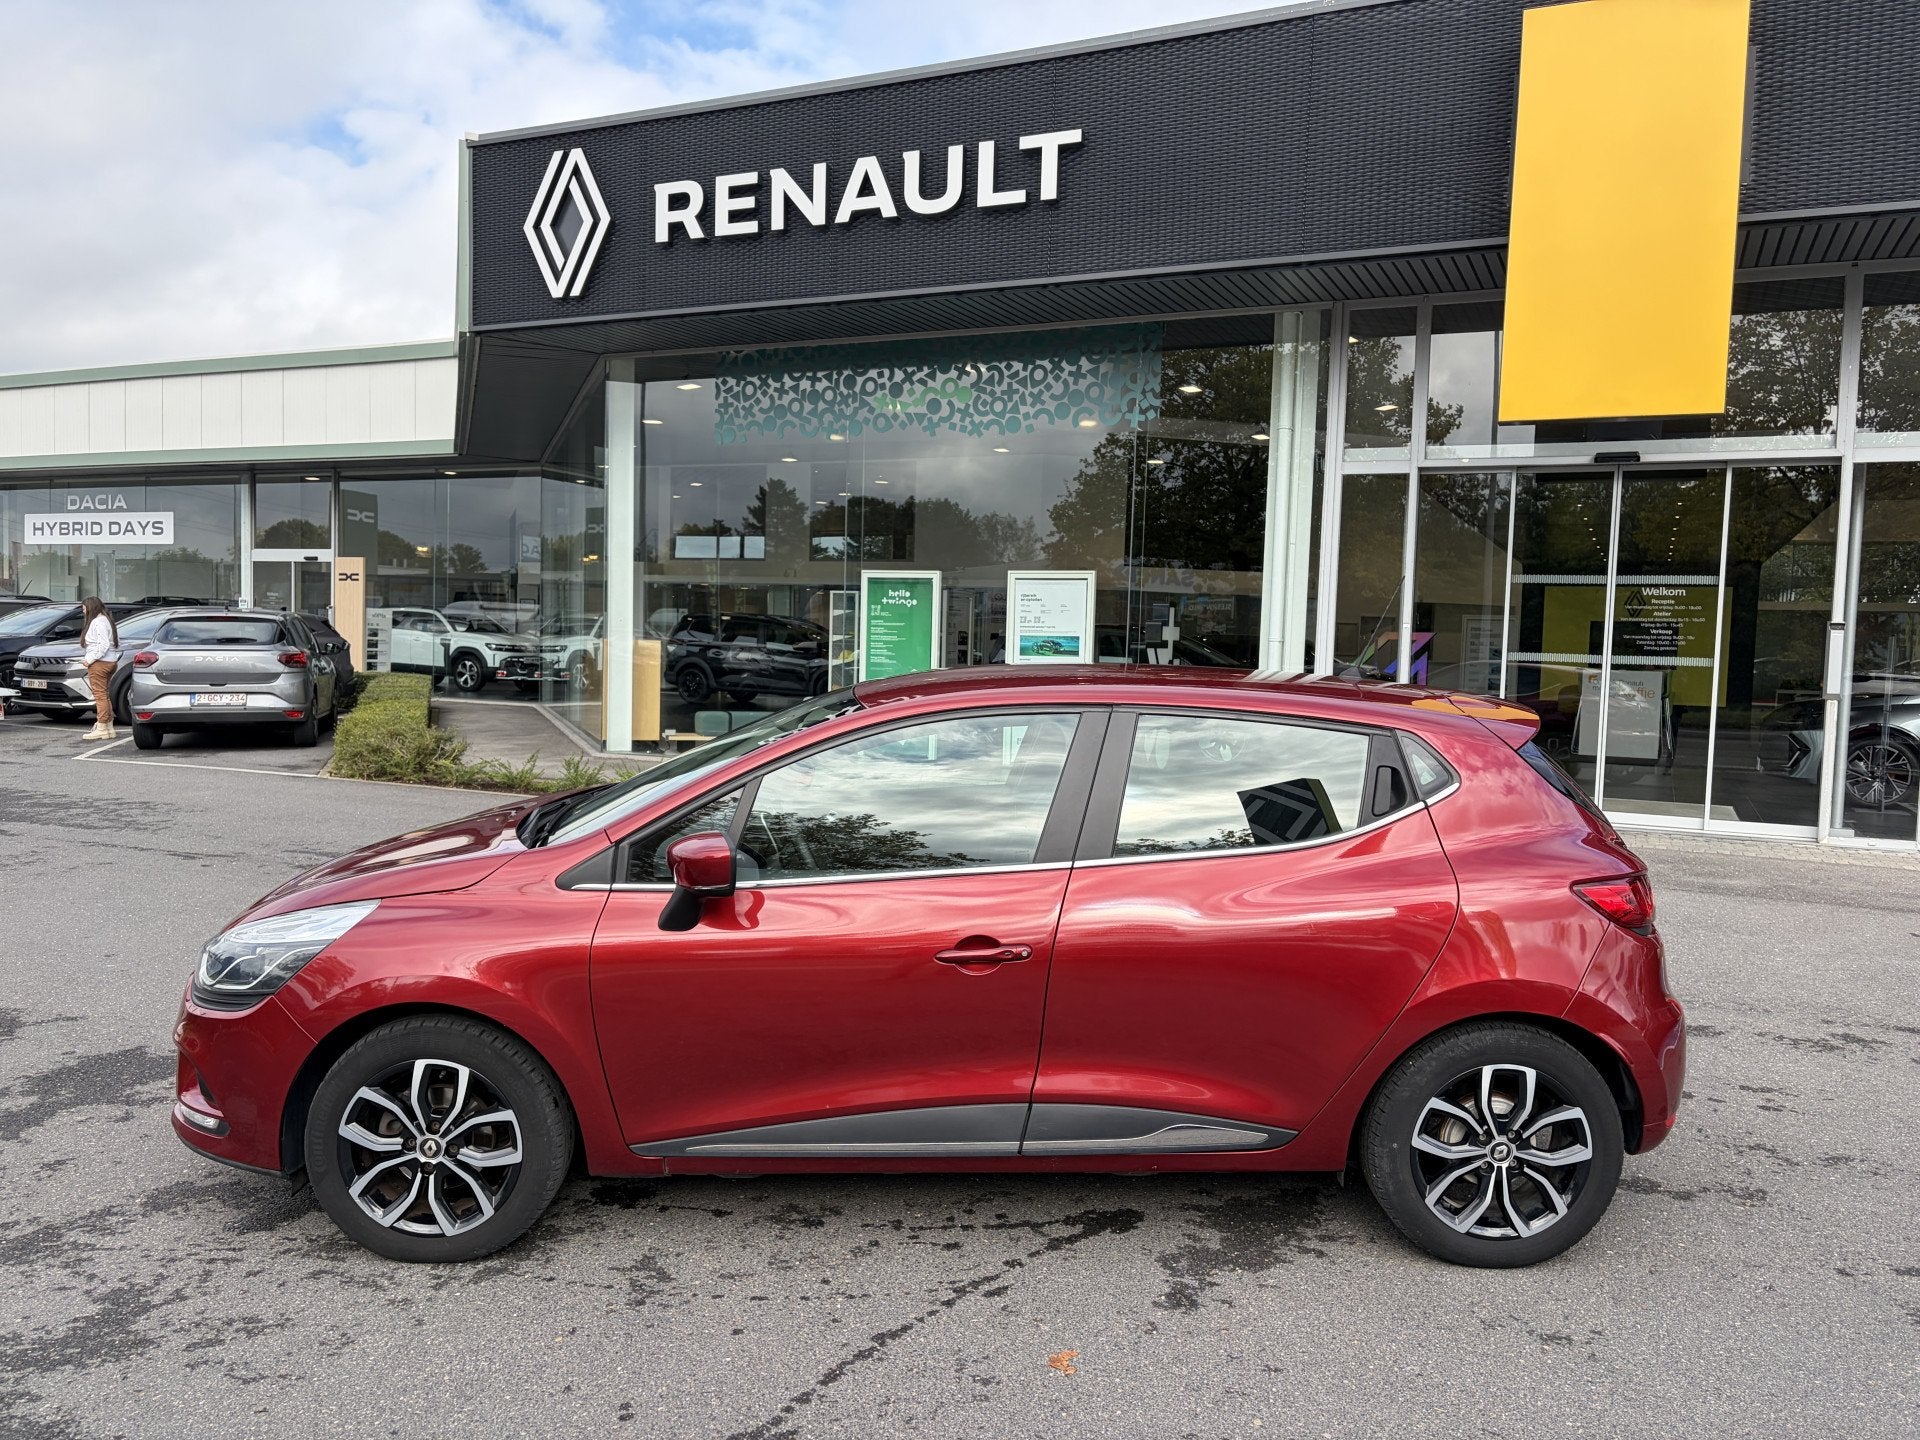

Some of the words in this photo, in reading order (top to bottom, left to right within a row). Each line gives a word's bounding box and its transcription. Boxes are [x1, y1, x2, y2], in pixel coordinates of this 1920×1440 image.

[654, 129, 1083, 243] RENAULT
[66, 494, 128, 510] DACIA
[32, 521, 103, 536] HYBRID
[108, 520, 164, 536] DAYS
[888, 589, 911, 597] hello
[1641, 587, 1686, 596] Welkom
